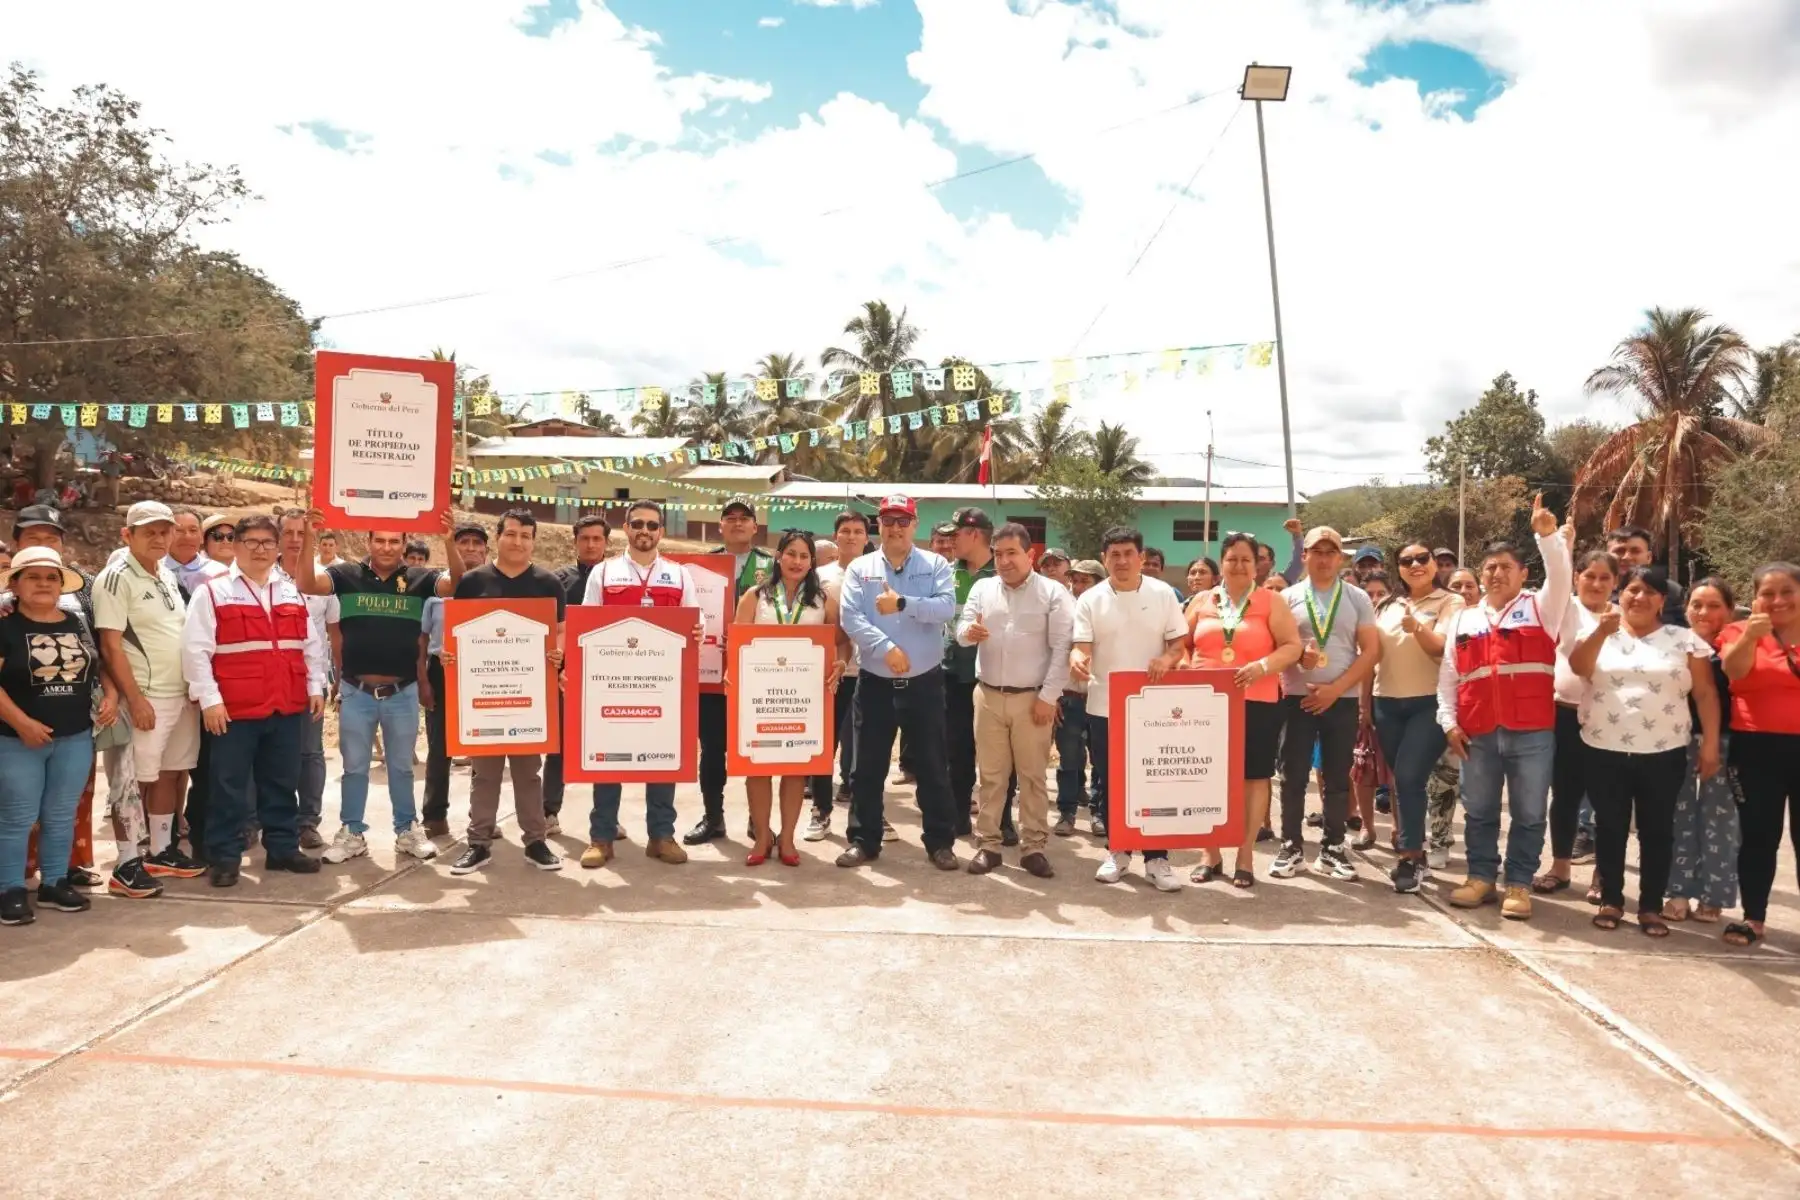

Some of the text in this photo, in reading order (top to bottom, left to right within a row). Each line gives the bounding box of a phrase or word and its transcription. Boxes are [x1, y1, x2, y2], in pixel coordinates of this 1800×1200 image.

[351, 402, 386, 412] Gobierno
[388, 403, 400, 412] del
[366, 428, 403, 439] TÍTULO
[348, 439, 420, 451] DE PROPIEDAD
[352, 450, 415, 461] REGISTRADO
[356, 595, 389, 608] POLO
[599, 648, 634, 657] Gobierno
[43, 685, 73, 693] AMOUR
[765, 697, 811, 705] PROPIEDAD
[603, 708, 660, 716] CAJAMARCA
[1143, 720, 1179, 728] Gobierno
[1159, 744, 1196, 754] TÍTULO
[1142, 756, 1212, 766] DE PROPIEDAD
[1146, 767, 1208, 777] REGISTRADO
